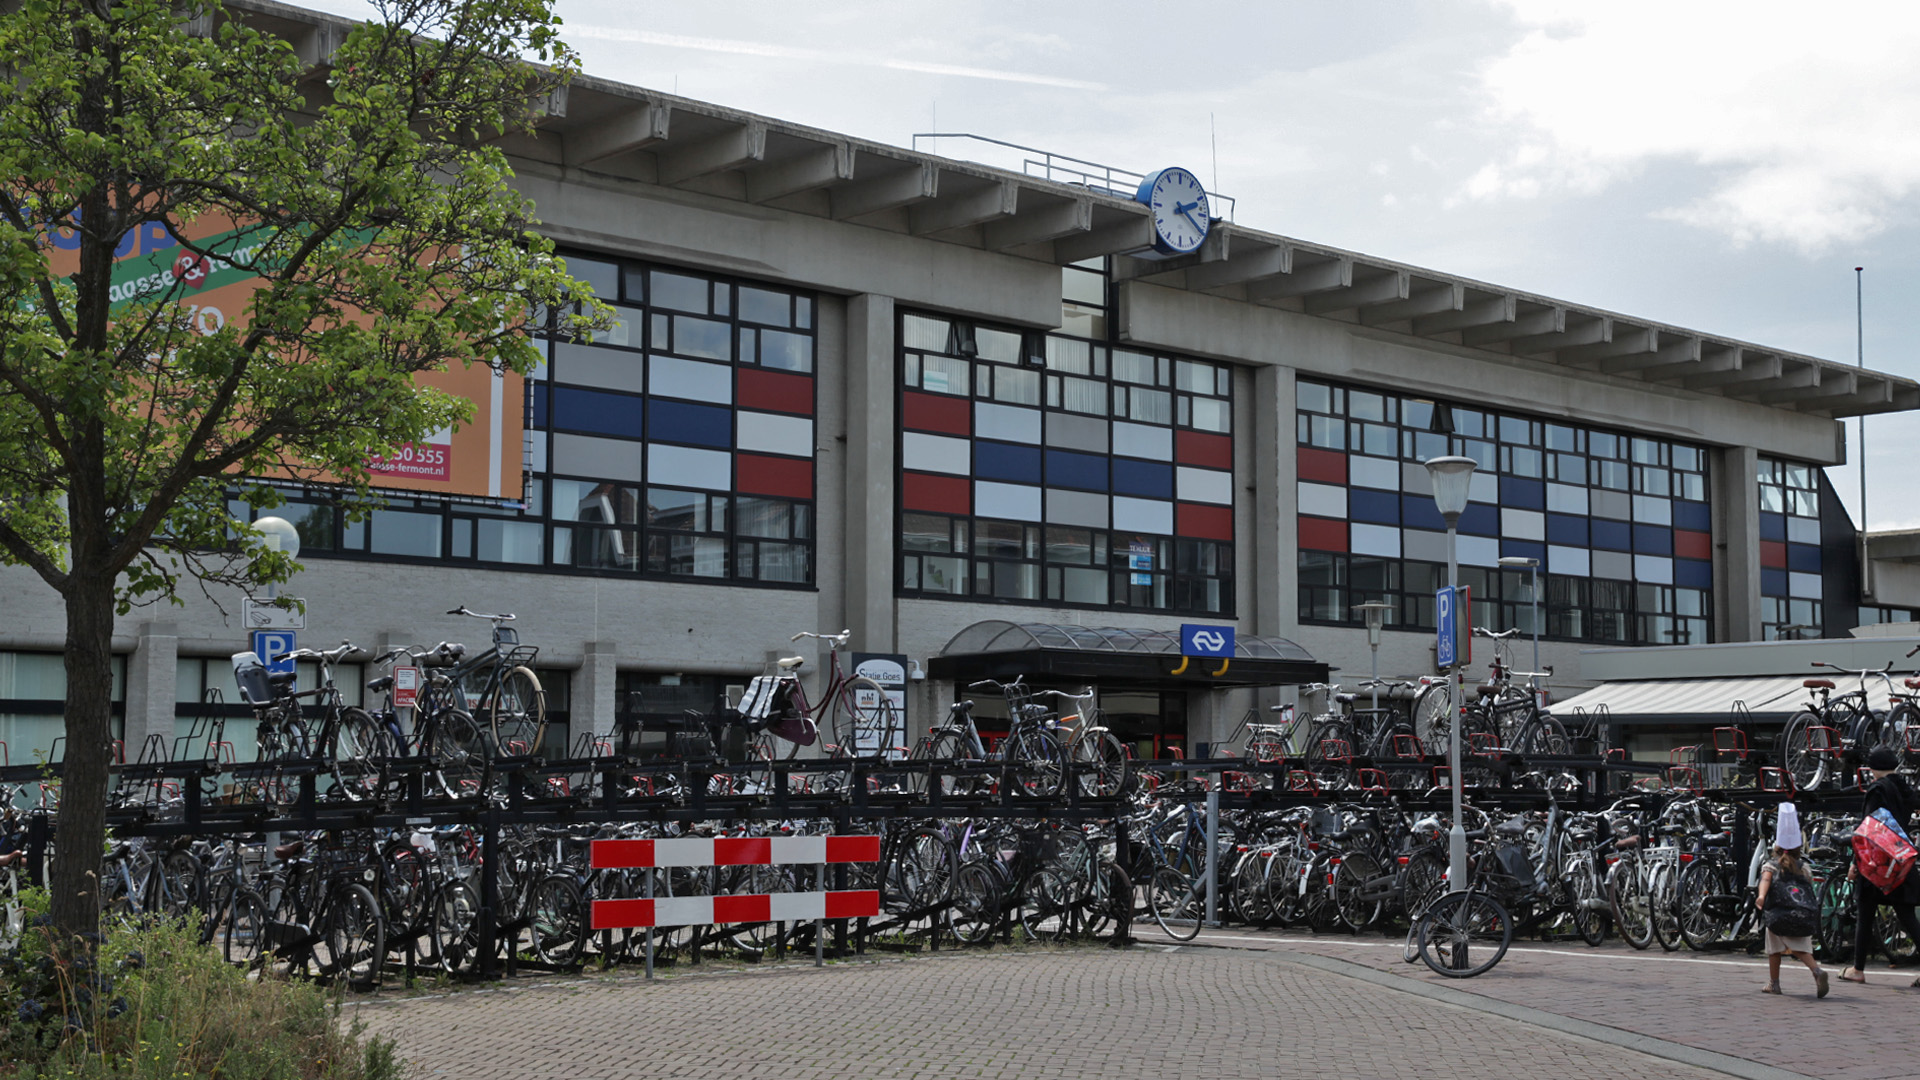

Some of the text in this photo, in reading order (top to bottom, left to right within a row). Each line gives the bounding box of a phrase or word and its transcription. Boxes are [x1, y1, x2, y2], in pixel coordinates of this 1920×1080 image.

[108, 269, 177, 303] aasse
[416, 449, 444, 464] 555
[1440, 594, 1449, 632] P
[265, 635, 286, 666] P
